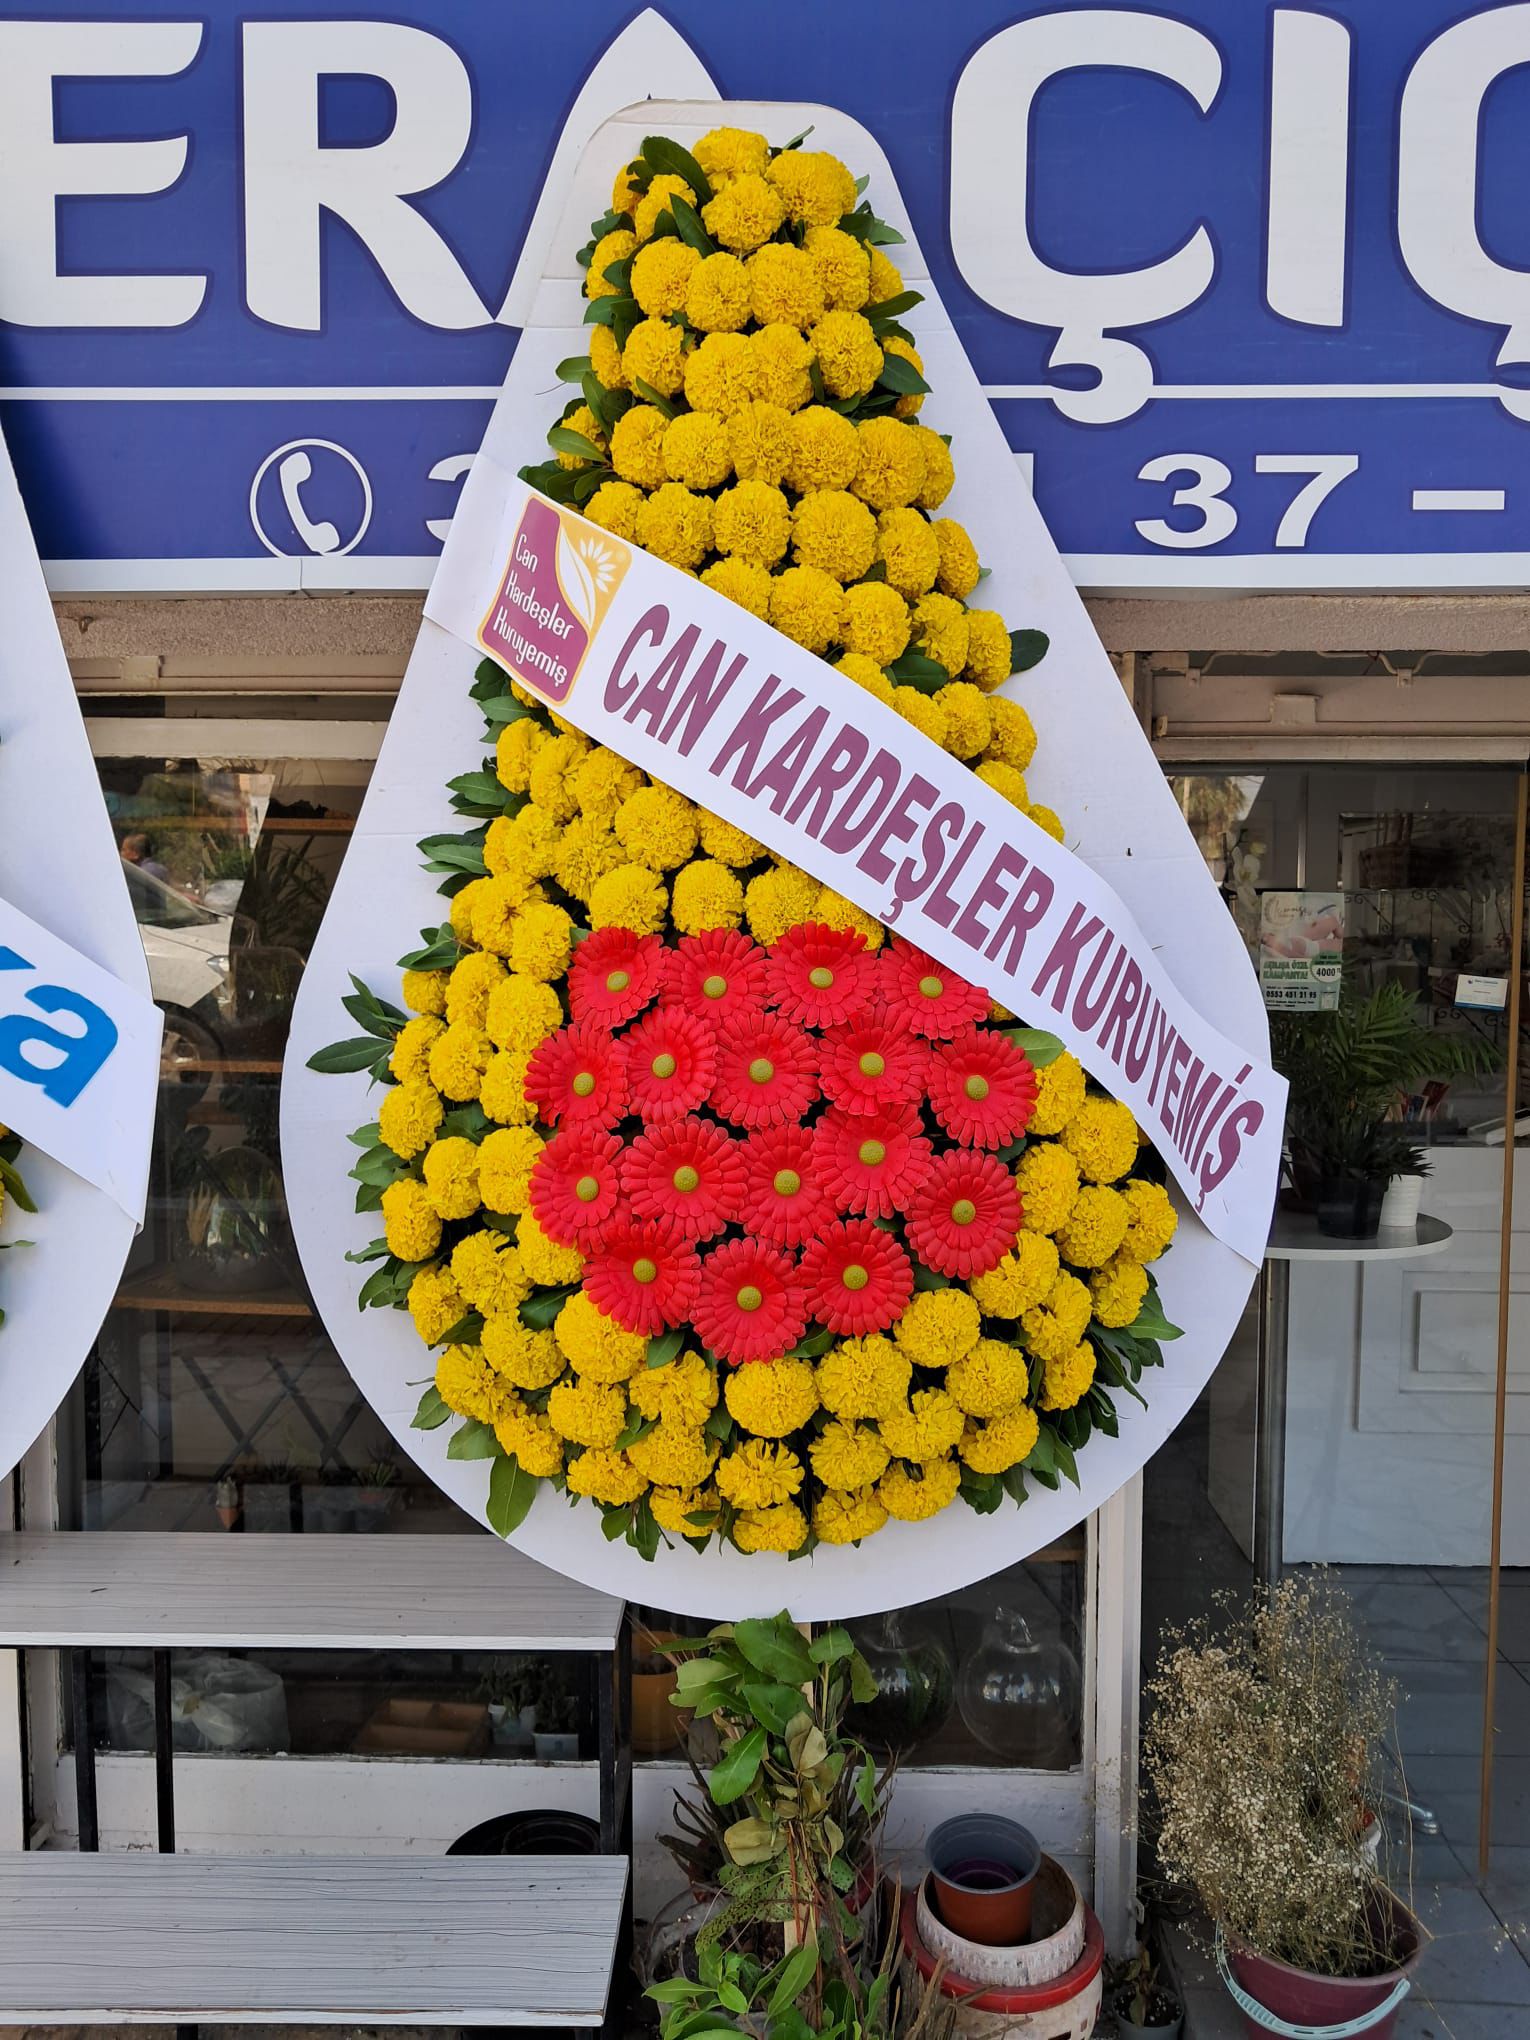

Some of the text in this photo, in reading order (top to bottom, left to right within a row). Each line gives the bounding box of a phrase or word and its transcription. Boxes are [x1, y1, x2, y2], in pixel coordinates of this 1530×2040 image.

[1135, 453, 1359, 548] 37
[515, 533, 538, 573] Can
[505, 569, 574, 640] Kardeşler
[492, 605, 568, 687] Kuruyemiş
[603, 604, 1265, 1213] CAN KARDEŞLER KURUYEMİŞ
[1266, 990, 1283, 998] 0553
[1316, 967, 1336, 977] 4000
